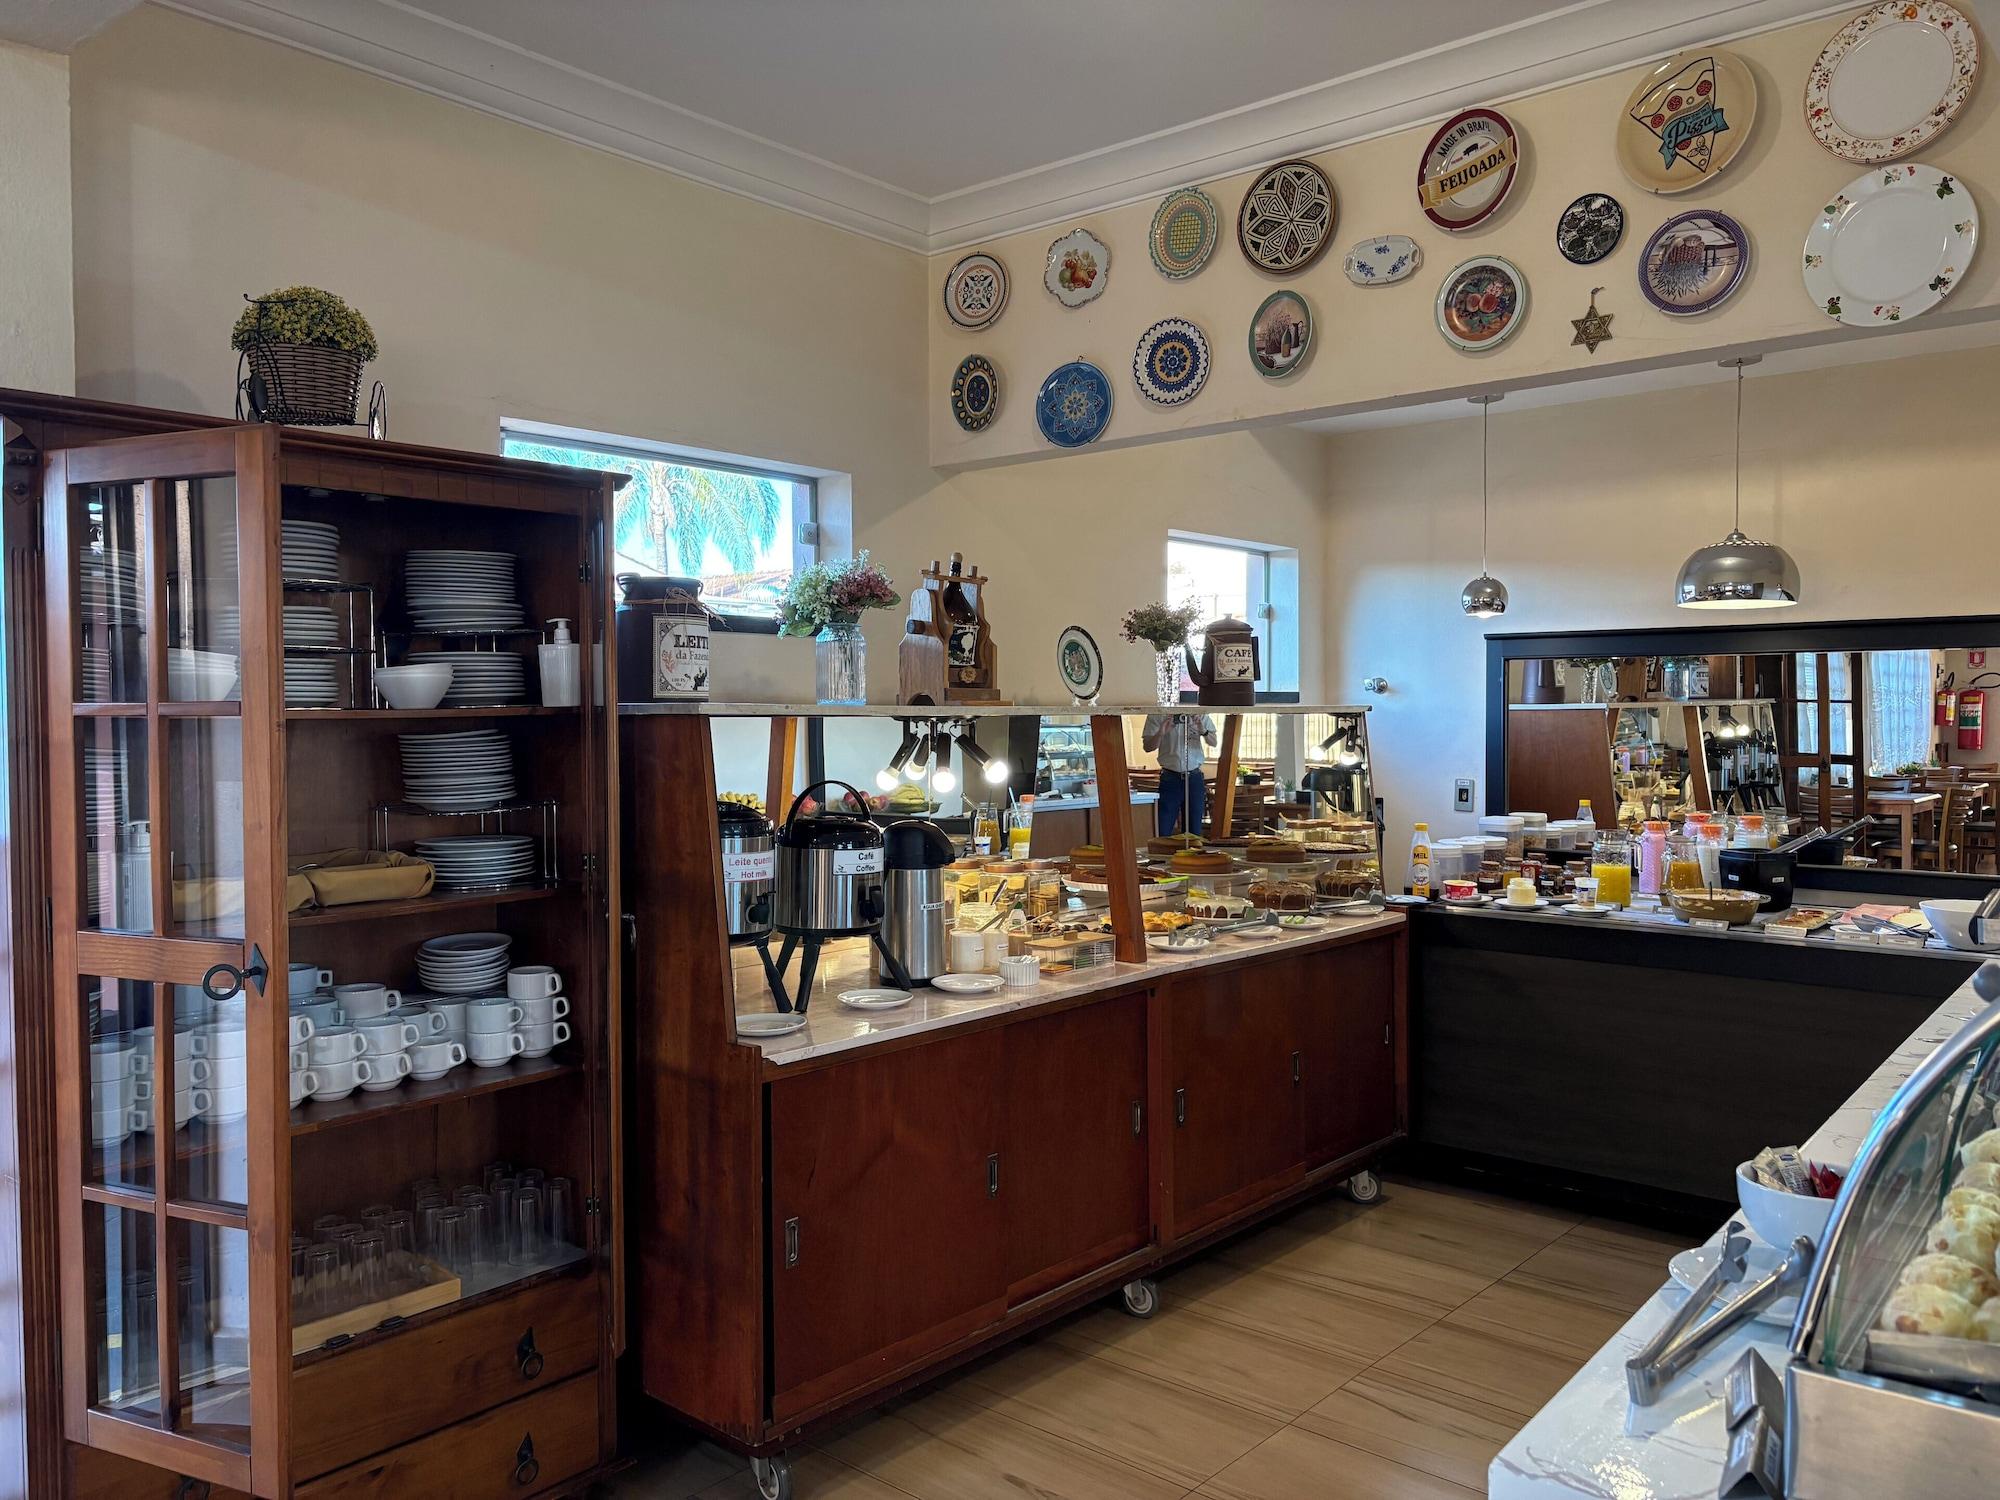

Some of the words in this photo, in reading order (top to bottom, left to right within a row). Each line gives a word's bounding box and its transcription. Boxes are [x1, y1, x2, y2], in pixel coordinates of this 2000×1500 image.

[1667, 116, 1712, 149] Pizza
[1437, 133, 1458, 158] MADE
[1456, 126, 1467, 138] IN
[1467, 121, 1491, 133] BRAZIL
[1439, 149, 1506, 193] FEIJOADA
[676, 650, 687, 660] da
[858, 851, 874, 861] Café
[729, 857, 752, 867] Leite
[741, 871, 754, 879] Hot
[755, 870, 767, 878] milk
